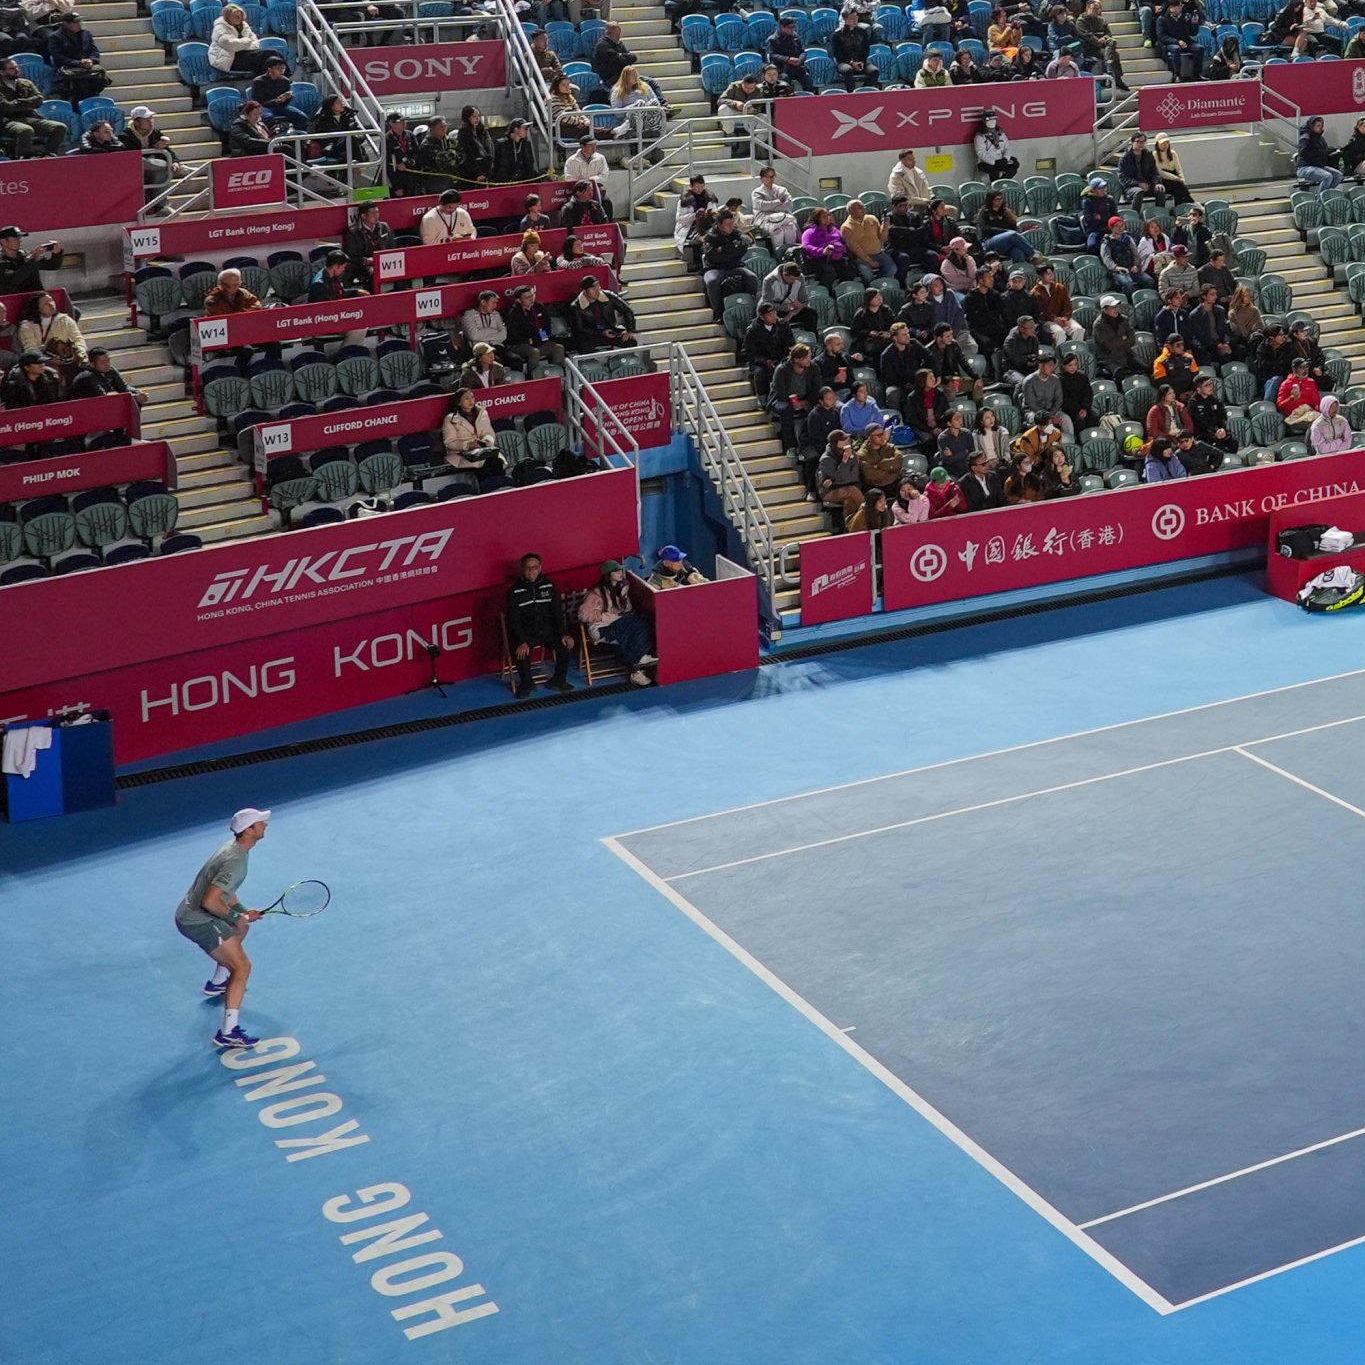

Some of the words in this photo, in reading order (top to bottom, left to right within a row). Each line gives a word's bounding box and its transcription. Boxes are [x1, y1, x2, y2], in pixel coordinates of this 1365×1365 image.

[364, 54, 484, 83] SONY
[1187, 94, 1246, 109] Diamanté
[895, 101, 1047, 128] XPENG
[228, 169, 272, 188] ECO
[208, 228, 227, 239] LGT
[228, 226, 246, 238] Bank
[248, 224, 268, 238] (Hong
[269, 222, 295, 237] Kong)
[132, 235, 159, 250] W15
[380, 258, 404, 272] W11
[417, 298, 440, 311] W10
[276, 317, 292, 329] LGT
[294, 315, 311, 328] Bank
[314, 313, 334, 327] (Hong
[336, 310, 363, 325] Kong)
[200, 325, 226, 339] W14
[323, 419, 365, 435] CLIFFORD
[367, 415, 398, 430] CHANCE
[264, 433, 290, 447] W13
[23, 470, 55, 485] PHILIP
[58, 467, 81, 481] MOK
[1195, 500, 1256, 527] BANK
[1294, 480, 1361, 508] CHINA
[241, 528, 455, 600] HKCTA
[197, 610, 225, 621] HONG
[255, 597, 284, 610] CHINA
[284, 591, 317, 604] TENNIS
[317, 579, 374, 596] ASSOCIATION
[140, 656, 296, 722] HONG
[333, 616, 473, 678] KONG
[220, 1035, 371, 1163] KONG
[322, 1181, 500, 1341] HONG
